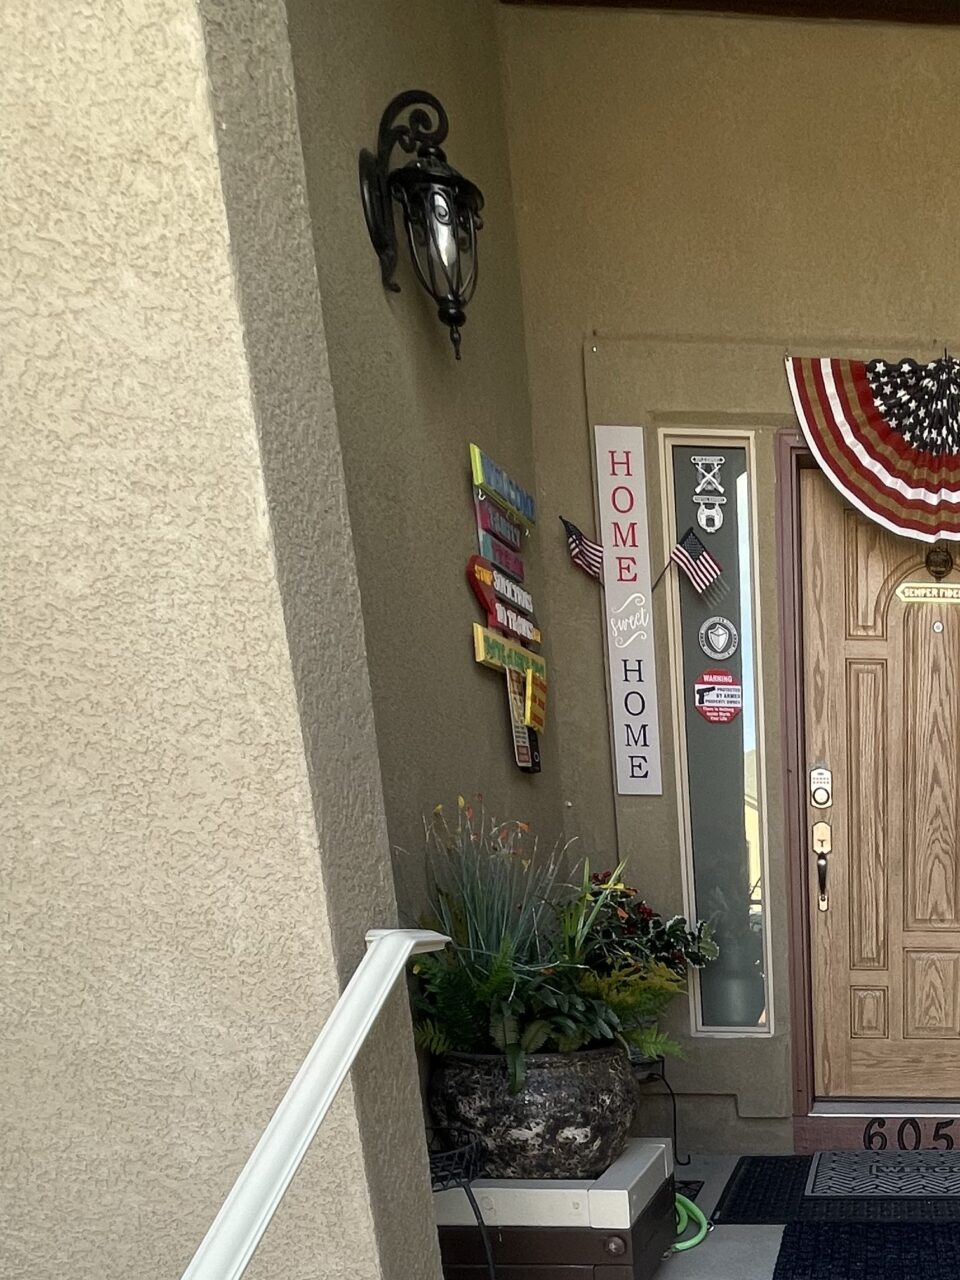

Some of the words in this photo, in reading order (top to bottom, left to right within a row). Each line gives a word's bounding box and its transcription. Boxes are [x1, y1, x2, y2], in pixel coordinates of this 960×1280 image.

[608, 450, 639, 582] HOME
[903, 588, 938, 598] SEMPER
[610, 608, 649, 637] sweet
[703, 674, 733, 683] WARNING
[621, 658, 650, 779] HOME
